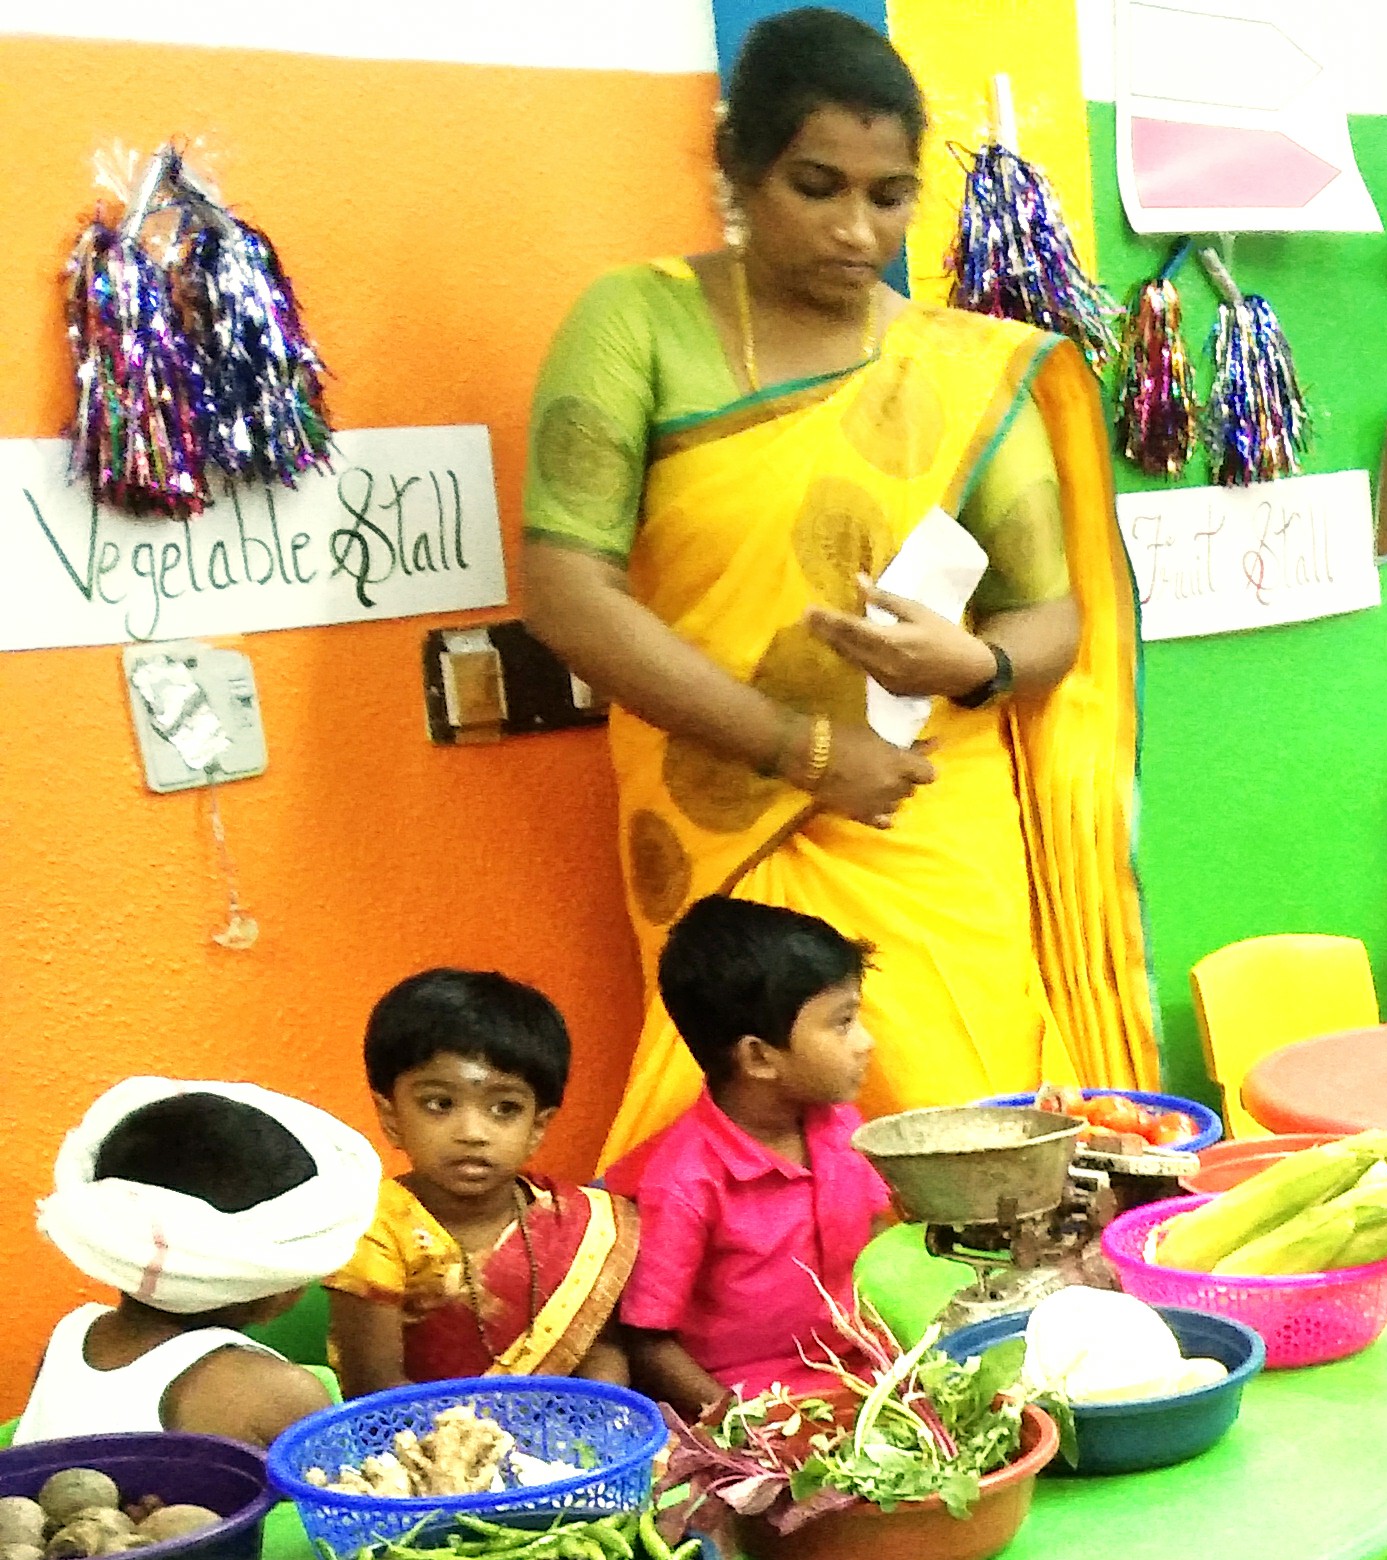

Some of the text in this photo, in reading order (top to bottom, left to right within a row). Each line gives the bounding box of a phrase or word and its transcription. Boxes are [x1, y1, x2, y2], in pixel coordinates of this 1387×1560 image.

[23, 467, 469, 643] Vegetable Stall
[1242, 501, 1335, 606] Stall
